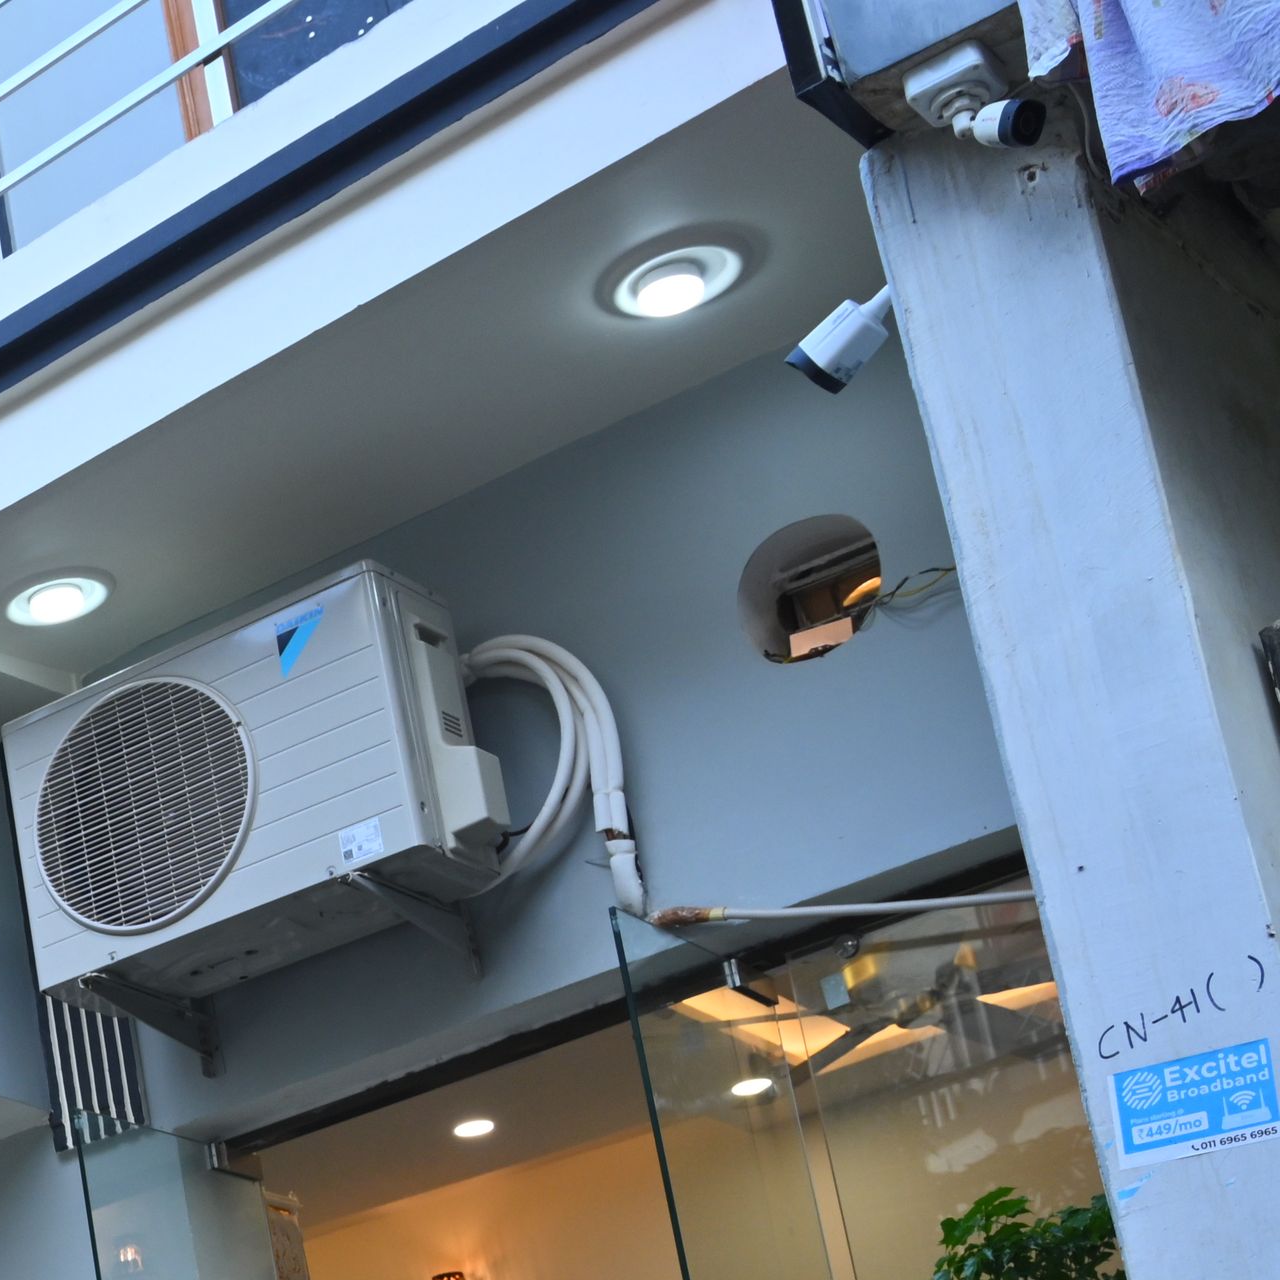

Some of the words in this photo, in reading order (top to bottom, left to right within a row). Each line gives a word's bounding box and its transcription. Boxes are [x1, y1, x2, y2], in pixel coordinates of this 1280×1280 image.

[1164, 1044, 1268, 1087] Excitel
[1167, 1068, 1269, 1102] Broadband
[1200, 1139, 1216, 1151] 011
[1220, 1134, 1247, 1147] 6965
[1251, 1126, 1278, 1139] 6965
